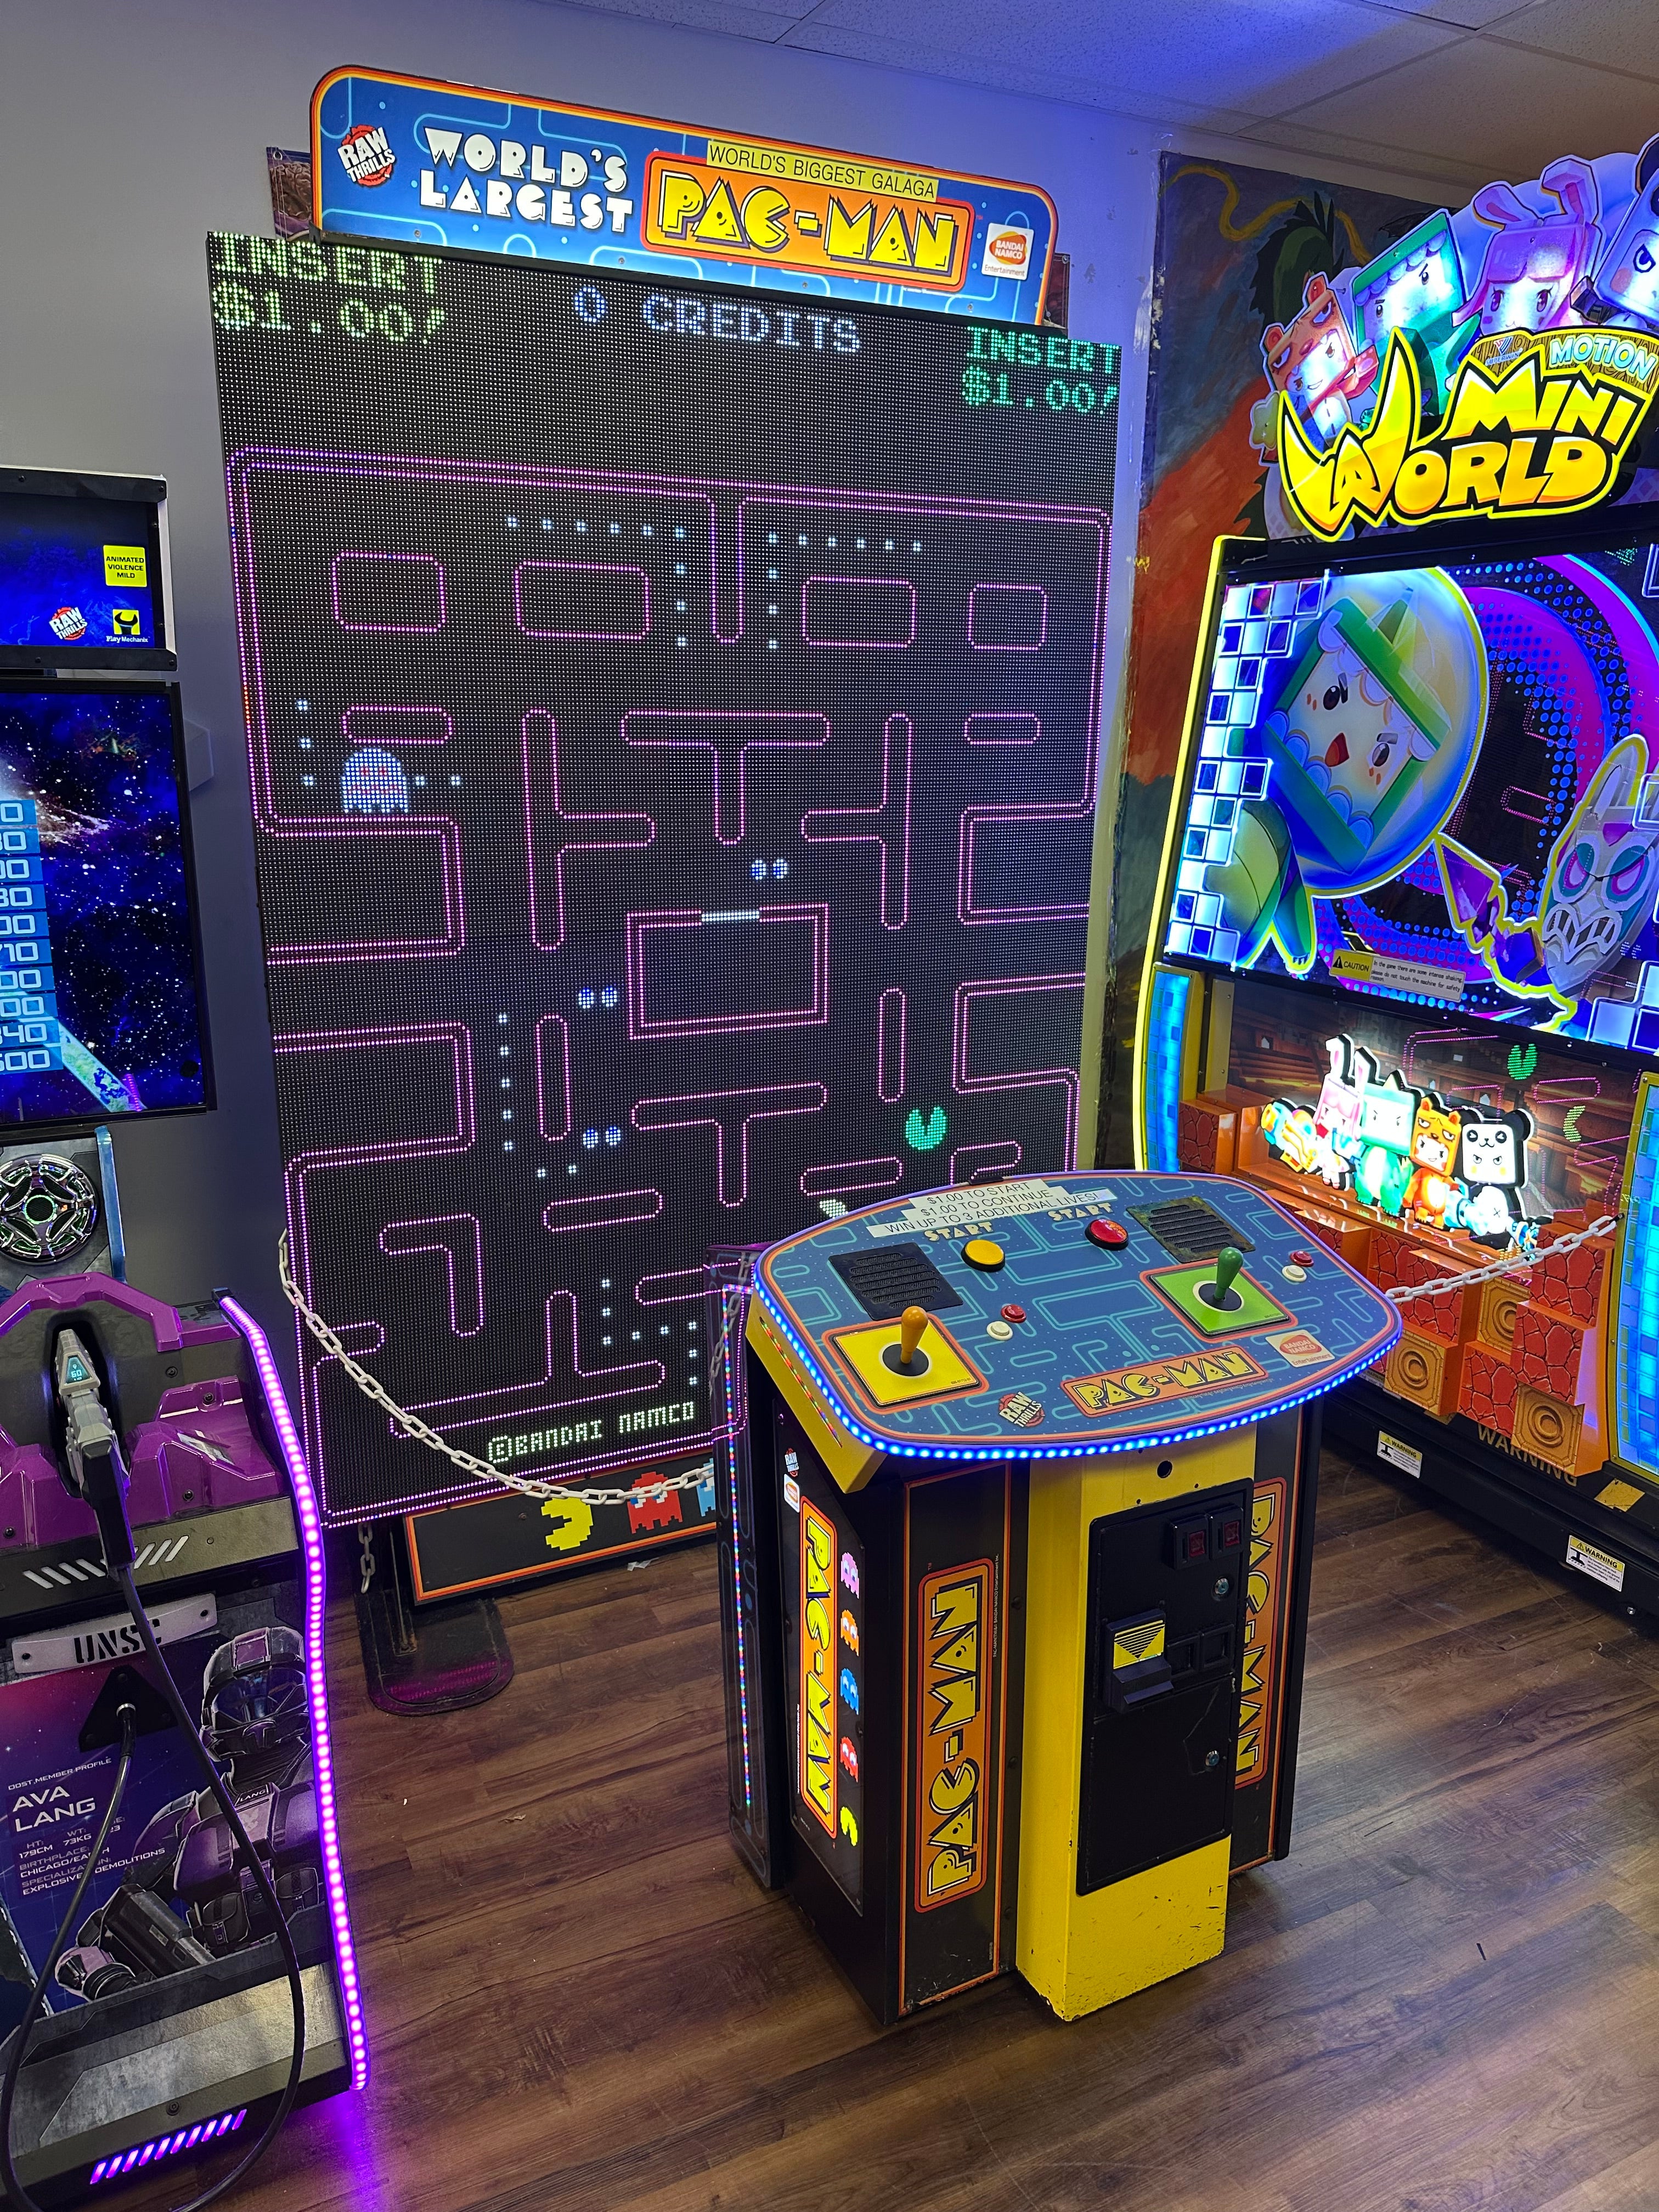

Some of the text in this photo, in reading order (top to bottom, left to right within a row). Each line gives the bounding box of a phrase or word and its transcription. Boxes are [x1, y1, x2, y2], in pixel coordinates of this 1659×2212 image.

[337, 126, 388, 170] RAW
[424, 127, 628, 193] WORLD'S
[347, 149, 396, 182] THRILLS
[709, 144, 935, 199] WORLD'S BIGGEST GALAGA
[419, 171, 633, 233] LARGEST
[658, 170, 958, 273] PAC-MAN
[995, 247, 1023, 260] NAMCO
[996, 240, 1024, 252] BANDAI
[213, 230, 442, 295] INSERT
[984, 264, 1025, 276] Entertainment
[574, 286, 860, 354] 0 CREDITS
[967, 326, 1119, 374] INSERT
[1486, 351, 1520, 366] SUPERWIN
[1550, 335, 1656, 380] MOTION
[1442, 358, 1638, 445] MINI
[1283, 347, 1607, 532] WORLD
[49, 607, 84, 633] RAW
[55, 619, 88, 640] THRILLS
[106, 635, 121, 644] Play
[1344, 961, 1369, 972] CAUTION
[921, 1189, 1053, 1217] $1.00 TO CONTINUE
[927, 1182, 1029, 1205] $1.00 TO START
[885, 1192, 1099, 1233] WIN UP TO 3 ADDITIONAL LIVES!
[1047, 1203, 1113, 1221] START
[924, 1221, 992, 1242] START
[1283, 1336, 1310, 1350] BANDAI
[1288, 1343, 1317, 1356] NAMCO
[1291, 1352, 1333, 1365] Entertainment
[71, 1369, 82, 1378] 60
[1073, 1351, 1258, 1410] PAC-MAN
[618, 1401, 695, 1435] NAMCO
[999, 1391, 1034, 1423] RAW
[1014, 1401, 1043, 1427] THRILLS
[1391, 1440, 1417, 1458] WARNING
[1585, 1545, 1618, 1568] WARNING
[806, 1515, 831, 1816] PAC-MAN
[927, 1575, 983, 1896] PAC-MAN
[35, 1769, 73, 1784] MEMBER
[76, 1758, 112, 1772] PROFILE
[13, 1786, 70, 1812] AVA
[240, 1788, 266, 1802] LANG
[15, 1798, 95, 1832] LANG
[19, 1844, 53, 1859] 179CM
[63, 1834, 92, 1847] 73KG
[27, 1840, 44, 1849] HT:
[67, 1828, 86, 1837] WT:
[20, 1846, 90, 1871] BIRTHPLACE:
[23, 1848, 166, 1895] EXPLOSIVE DEMOLITIONS
